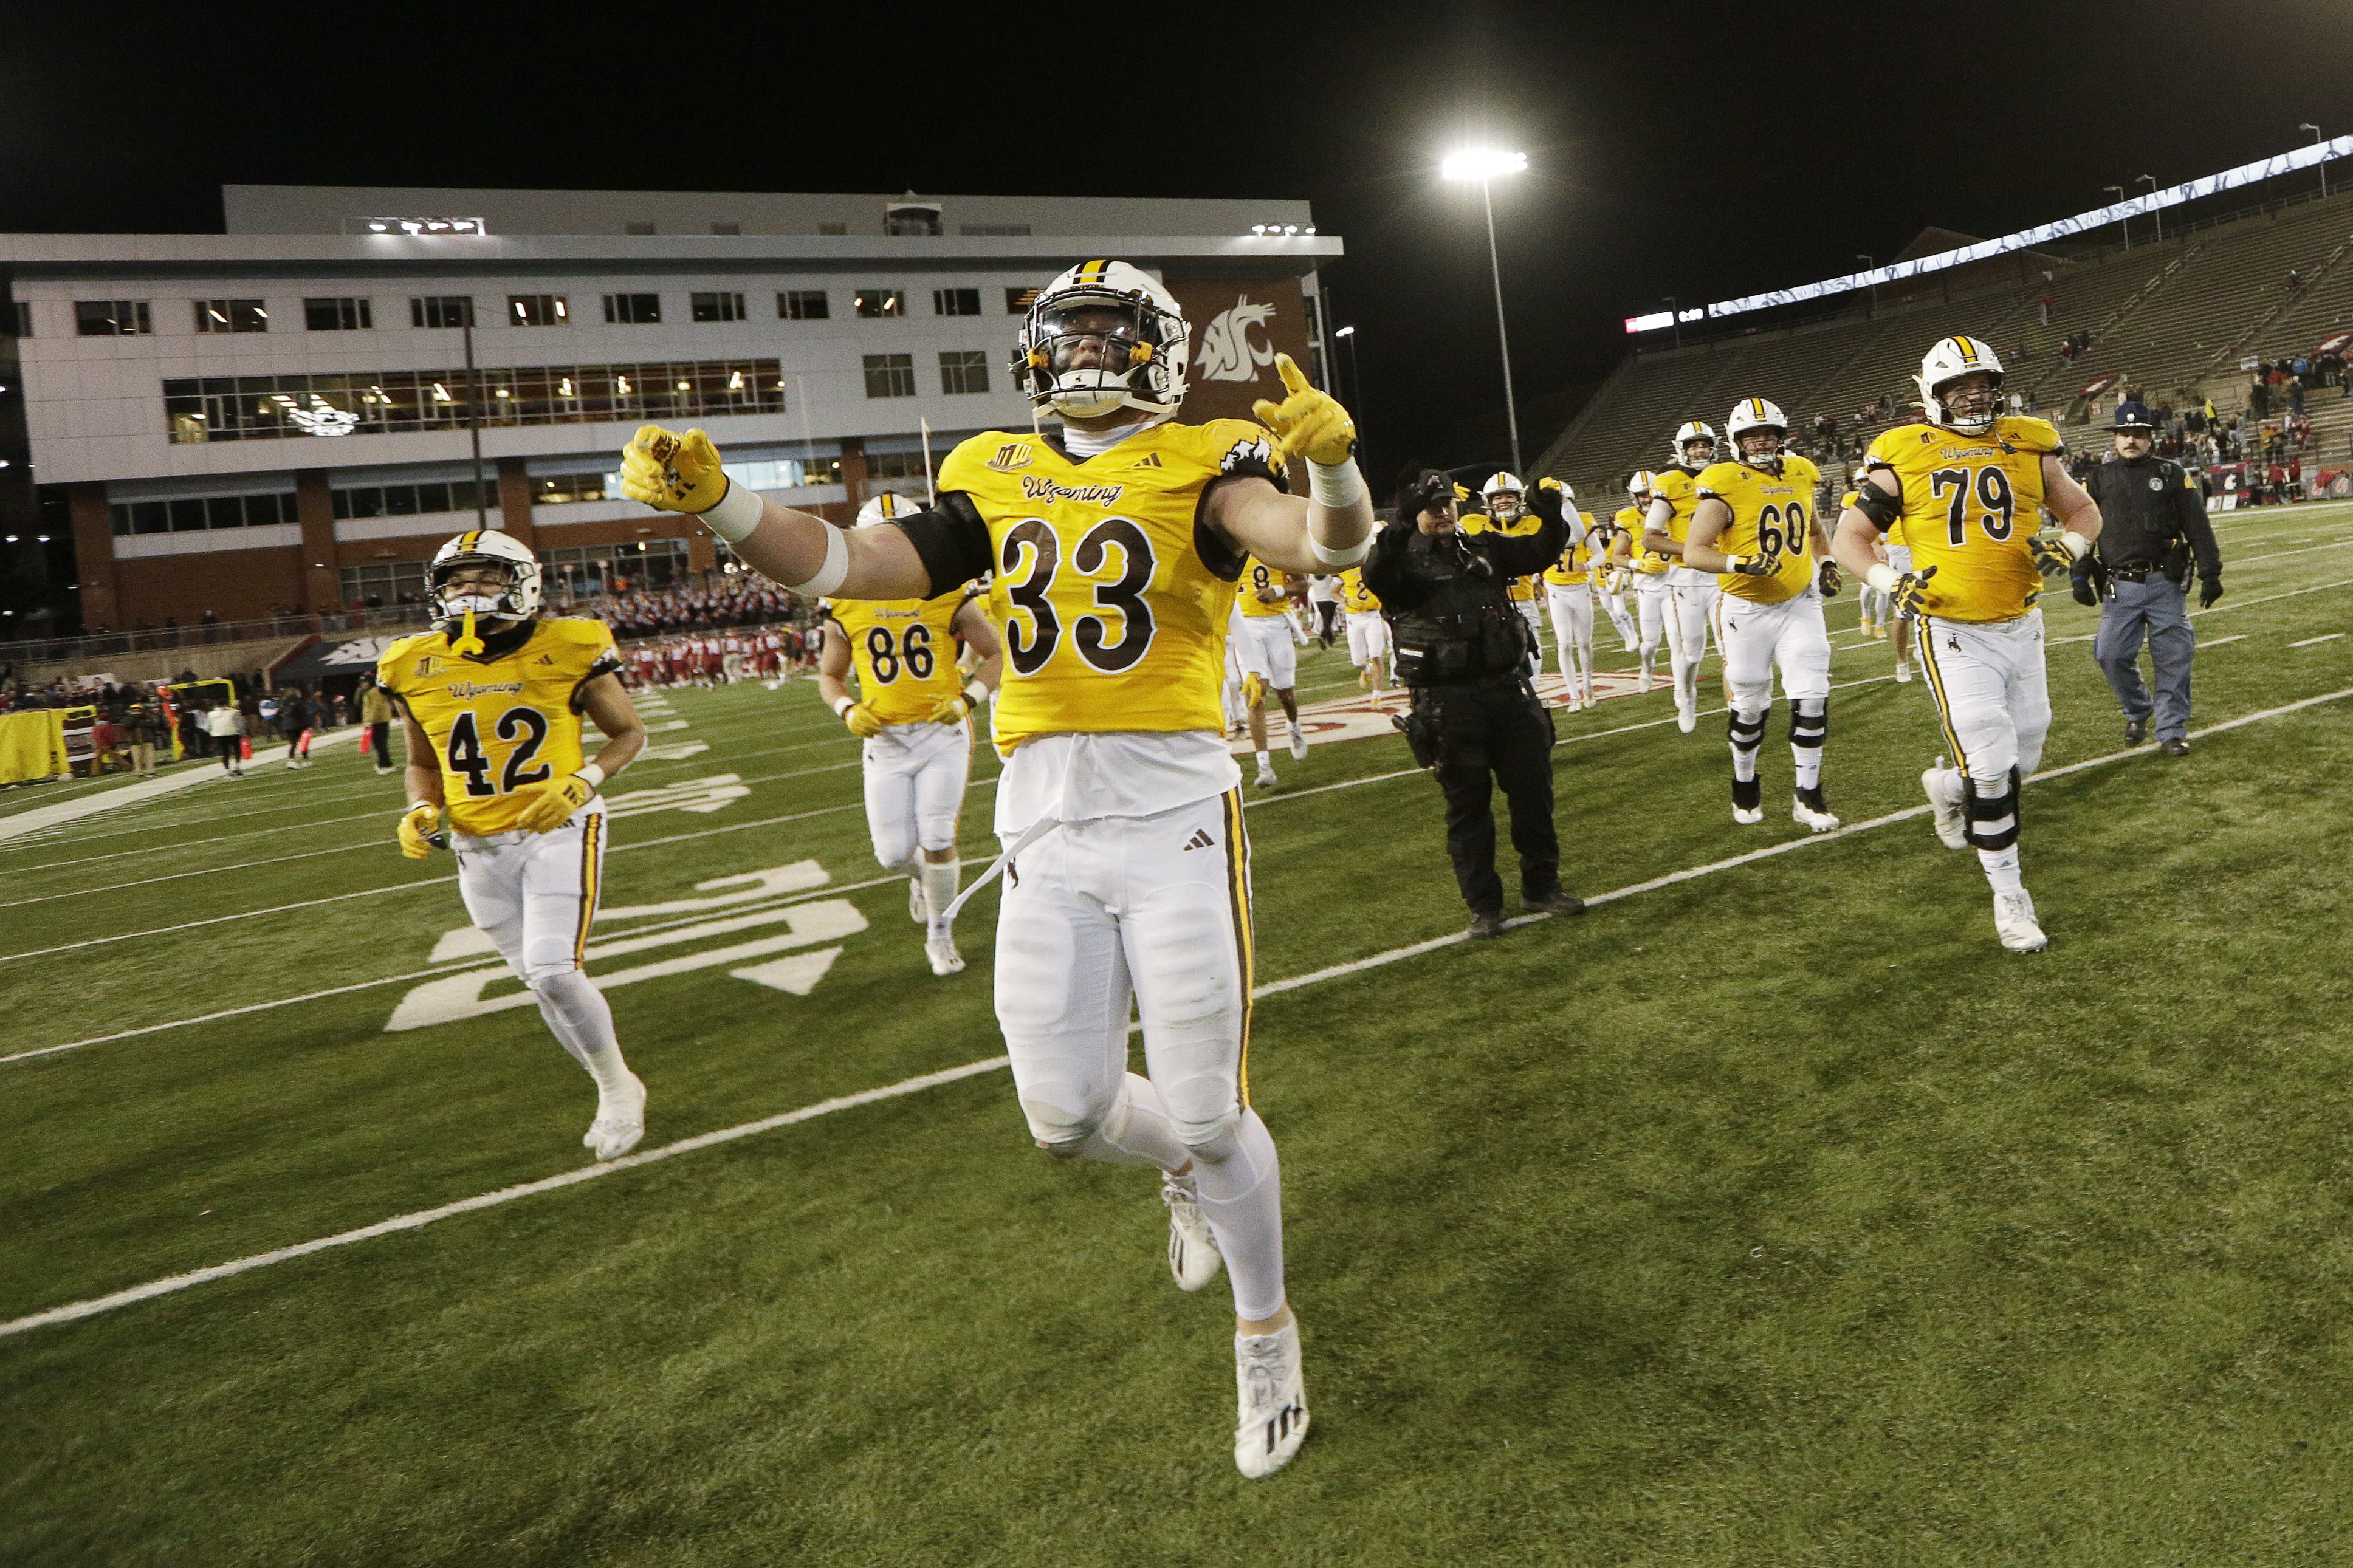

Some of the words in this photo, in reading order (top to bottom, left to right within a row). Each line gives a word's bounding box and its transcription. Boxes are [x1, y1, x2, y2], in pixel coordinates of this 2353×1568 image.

[1022, 474, 1124, 508] Wyoming
[1930, 465, 2015, 547] 79
[1757, 501, 1805, 558] 60
[1000, 516, 1160, 678] 33
[866, 622, 935, 686] 86
[448, 681, 523, 700] Wyoming
[446, 706, 554, 804] 42
